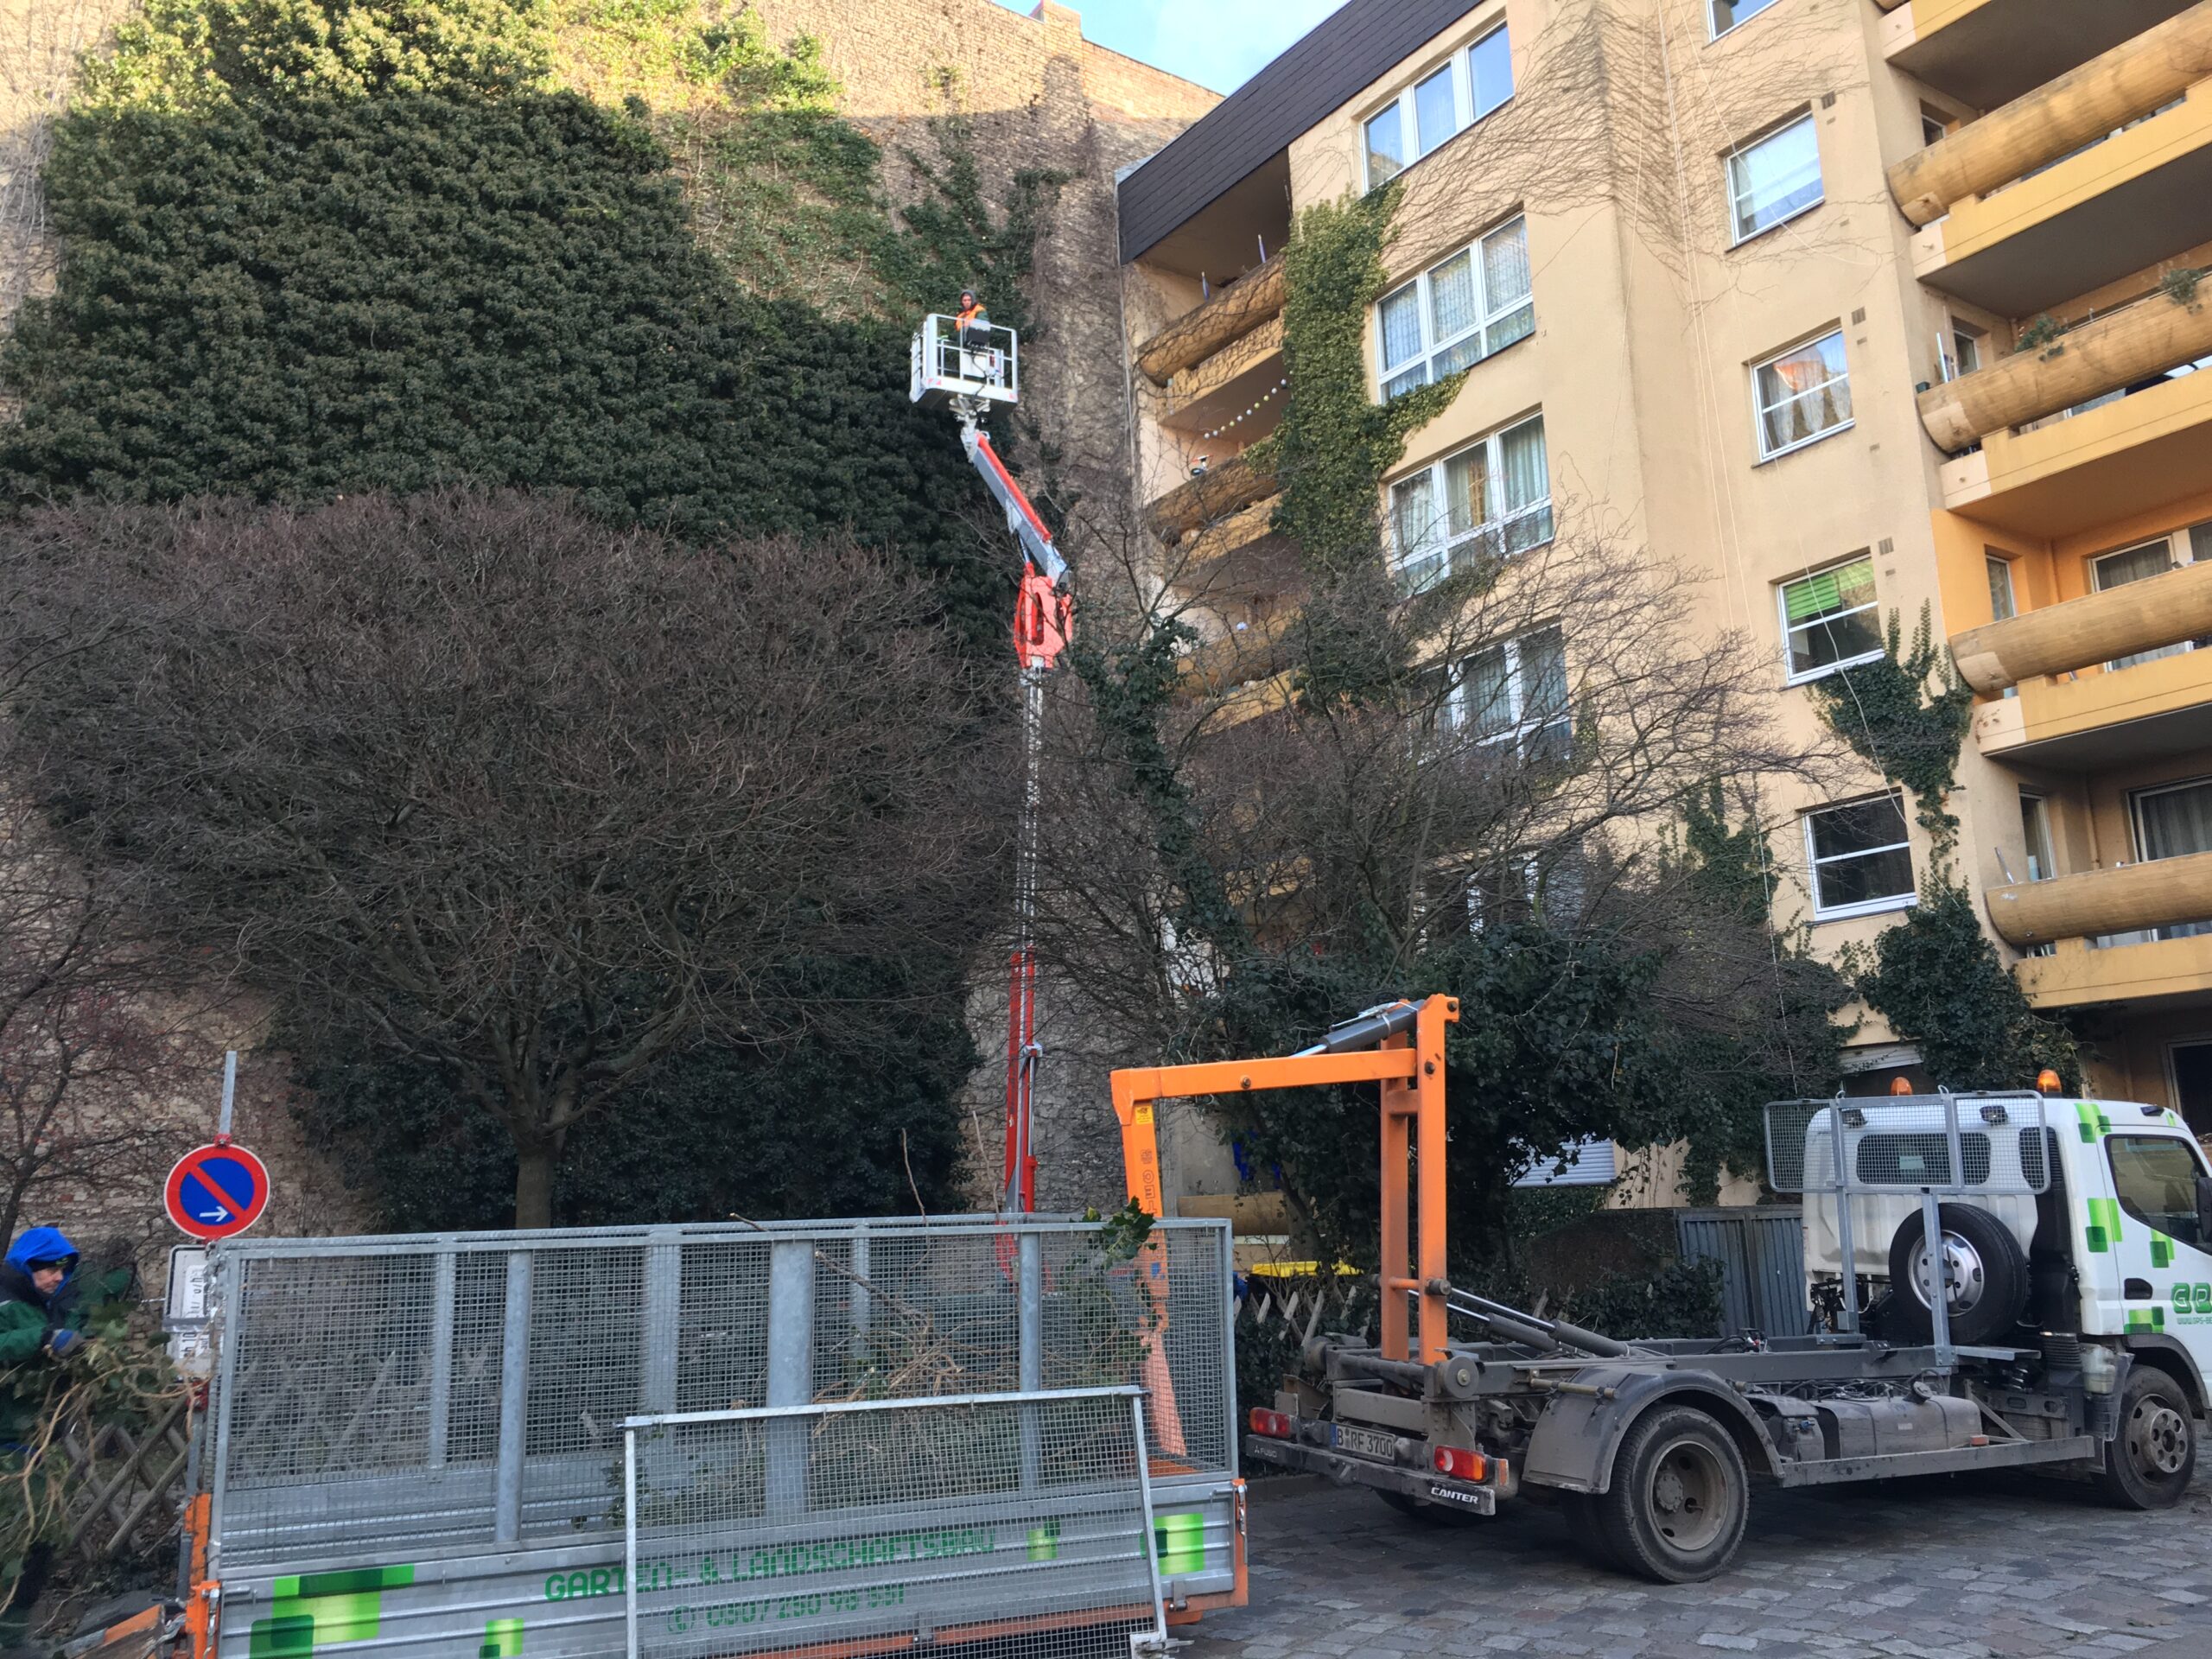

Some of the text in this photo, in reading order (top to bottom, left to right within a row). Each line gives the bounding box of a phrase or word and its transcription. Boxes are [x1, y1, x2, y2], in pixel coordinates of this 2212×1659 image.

[1261, 1448, 1277, 1458] FUSO
[1338, 1428, 1393, 1458] B RF 3700
[1430, 1486, 1478, 1504] CANTER
[732, 1528, 995, 1582] LANDSCHAFTSBAU
